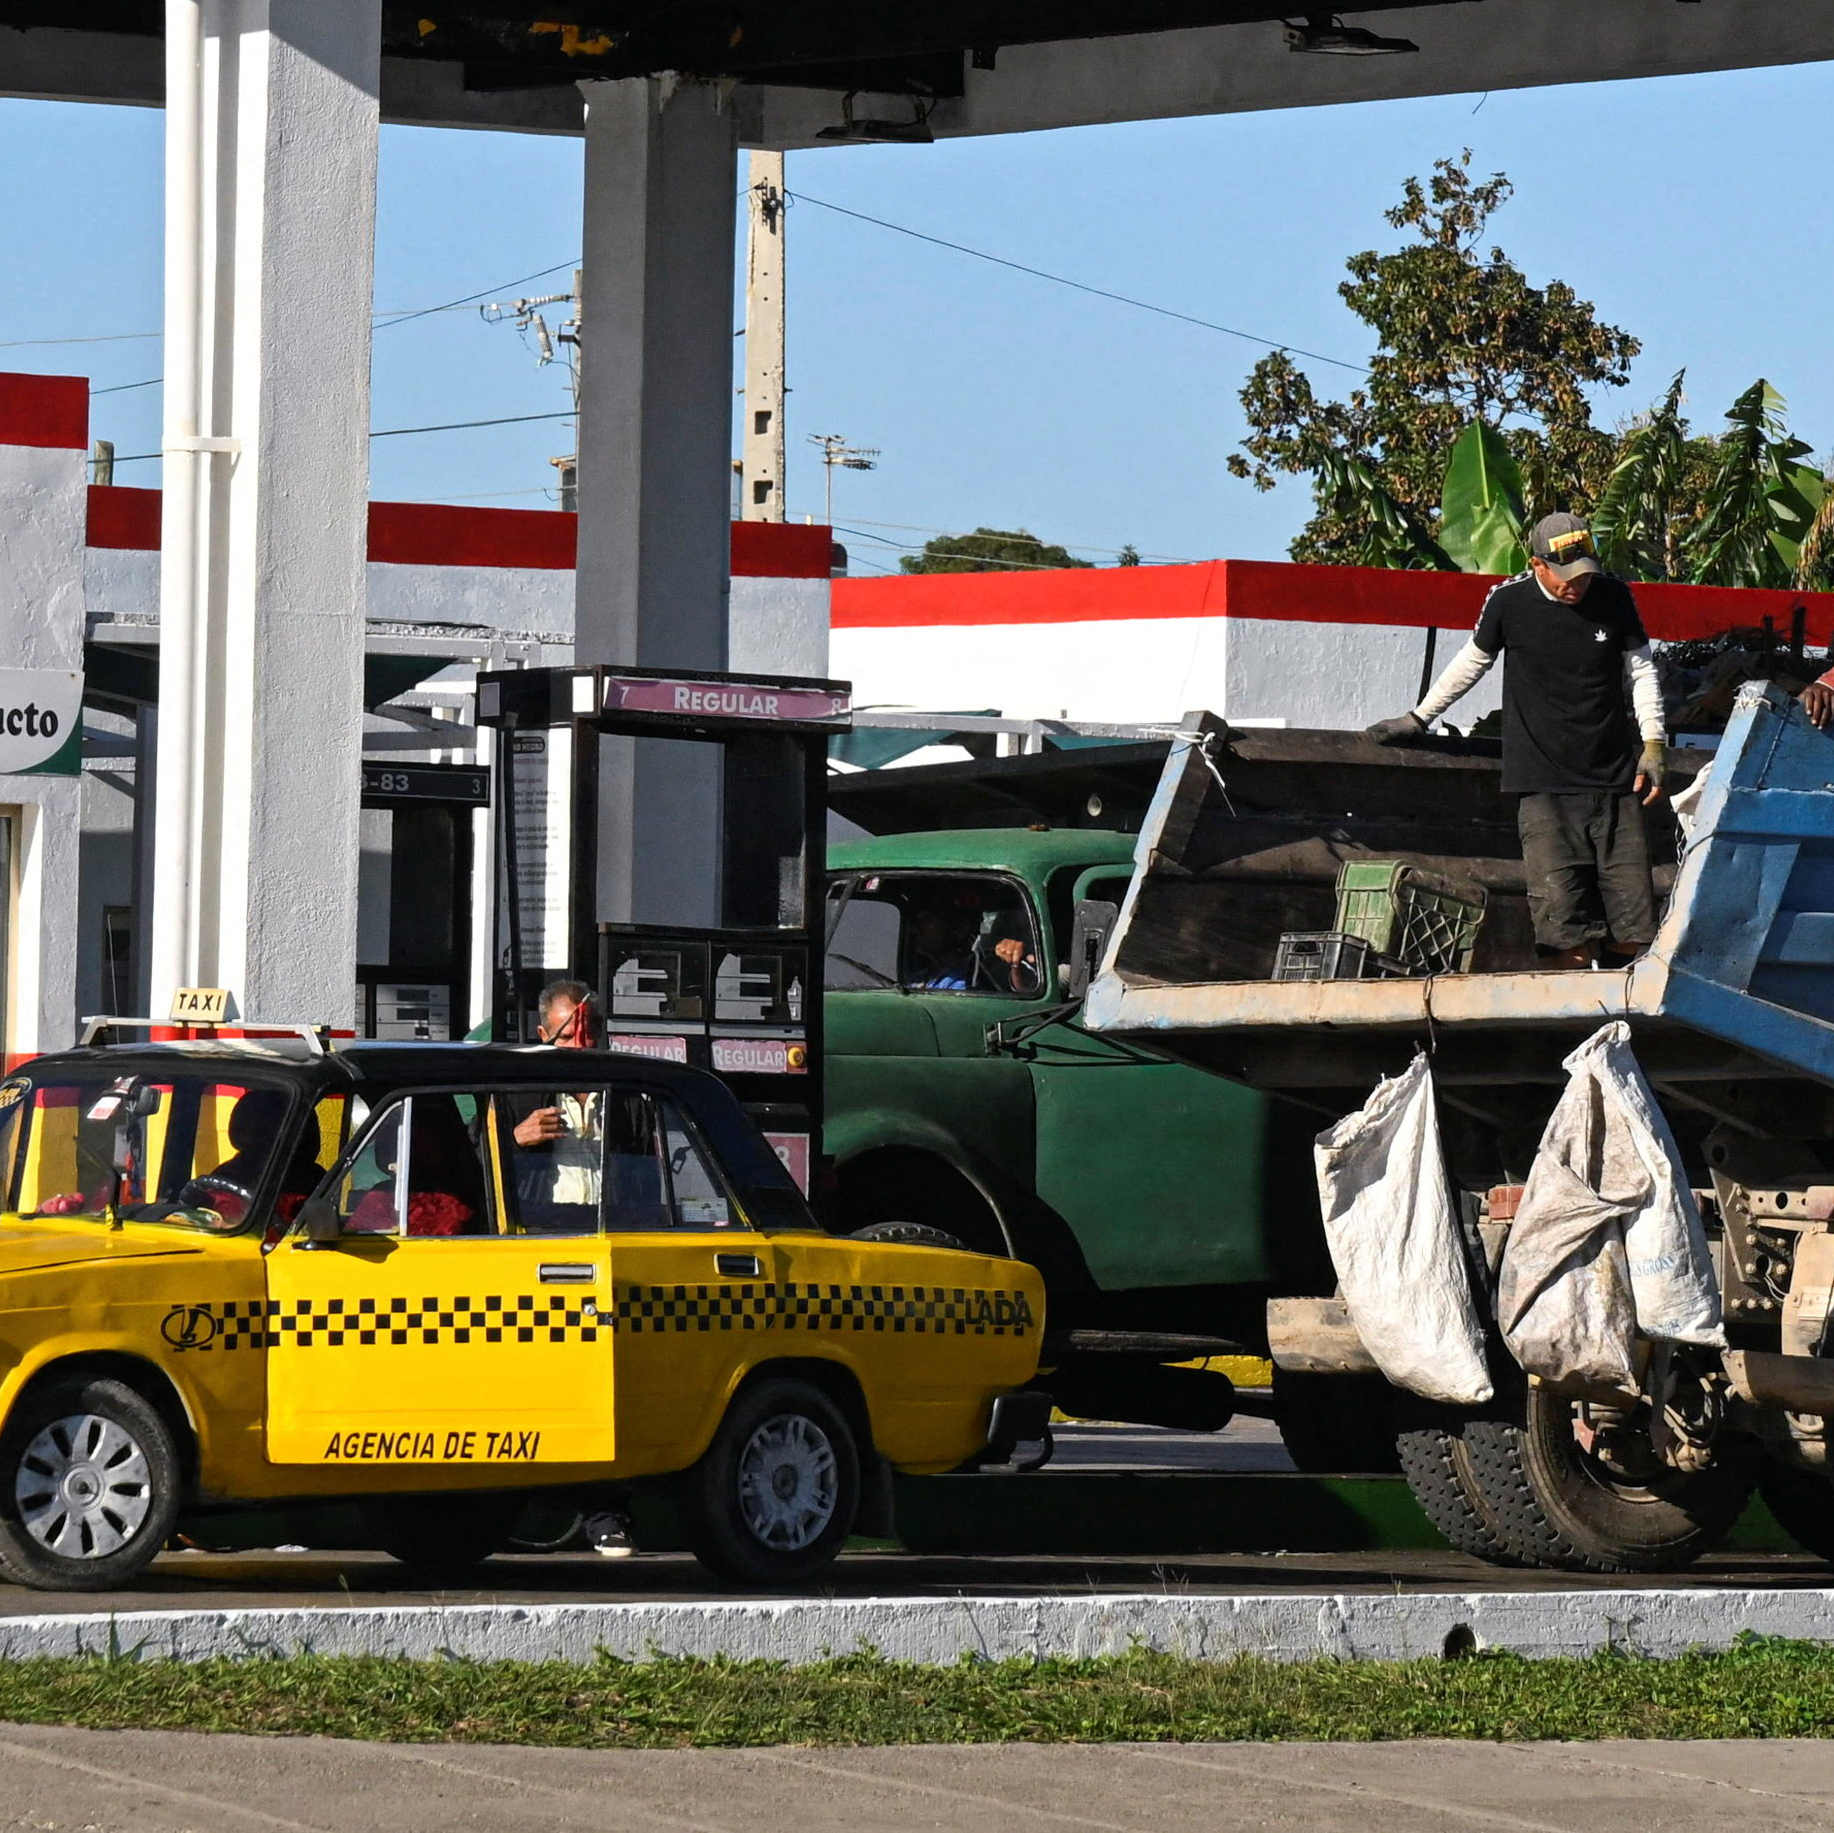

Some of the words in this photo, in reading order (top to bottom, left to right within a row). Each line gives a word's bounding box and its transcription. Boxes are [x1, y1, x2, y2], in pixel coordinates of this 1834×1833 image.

[674, 686, 779, 715] REGULAR
[472, 778, 481, 795] 3
[179, 993, 222, 1012] TAXI
[712, 1043, 785, 1067] REGULAR
[965, 1298, 1034, 1327] LADA
[323, 1432, 435, 1459] AGENCIA
[443, 1432, 477, 1459] DE
[486, 1431, 541, 1461] TAXI
